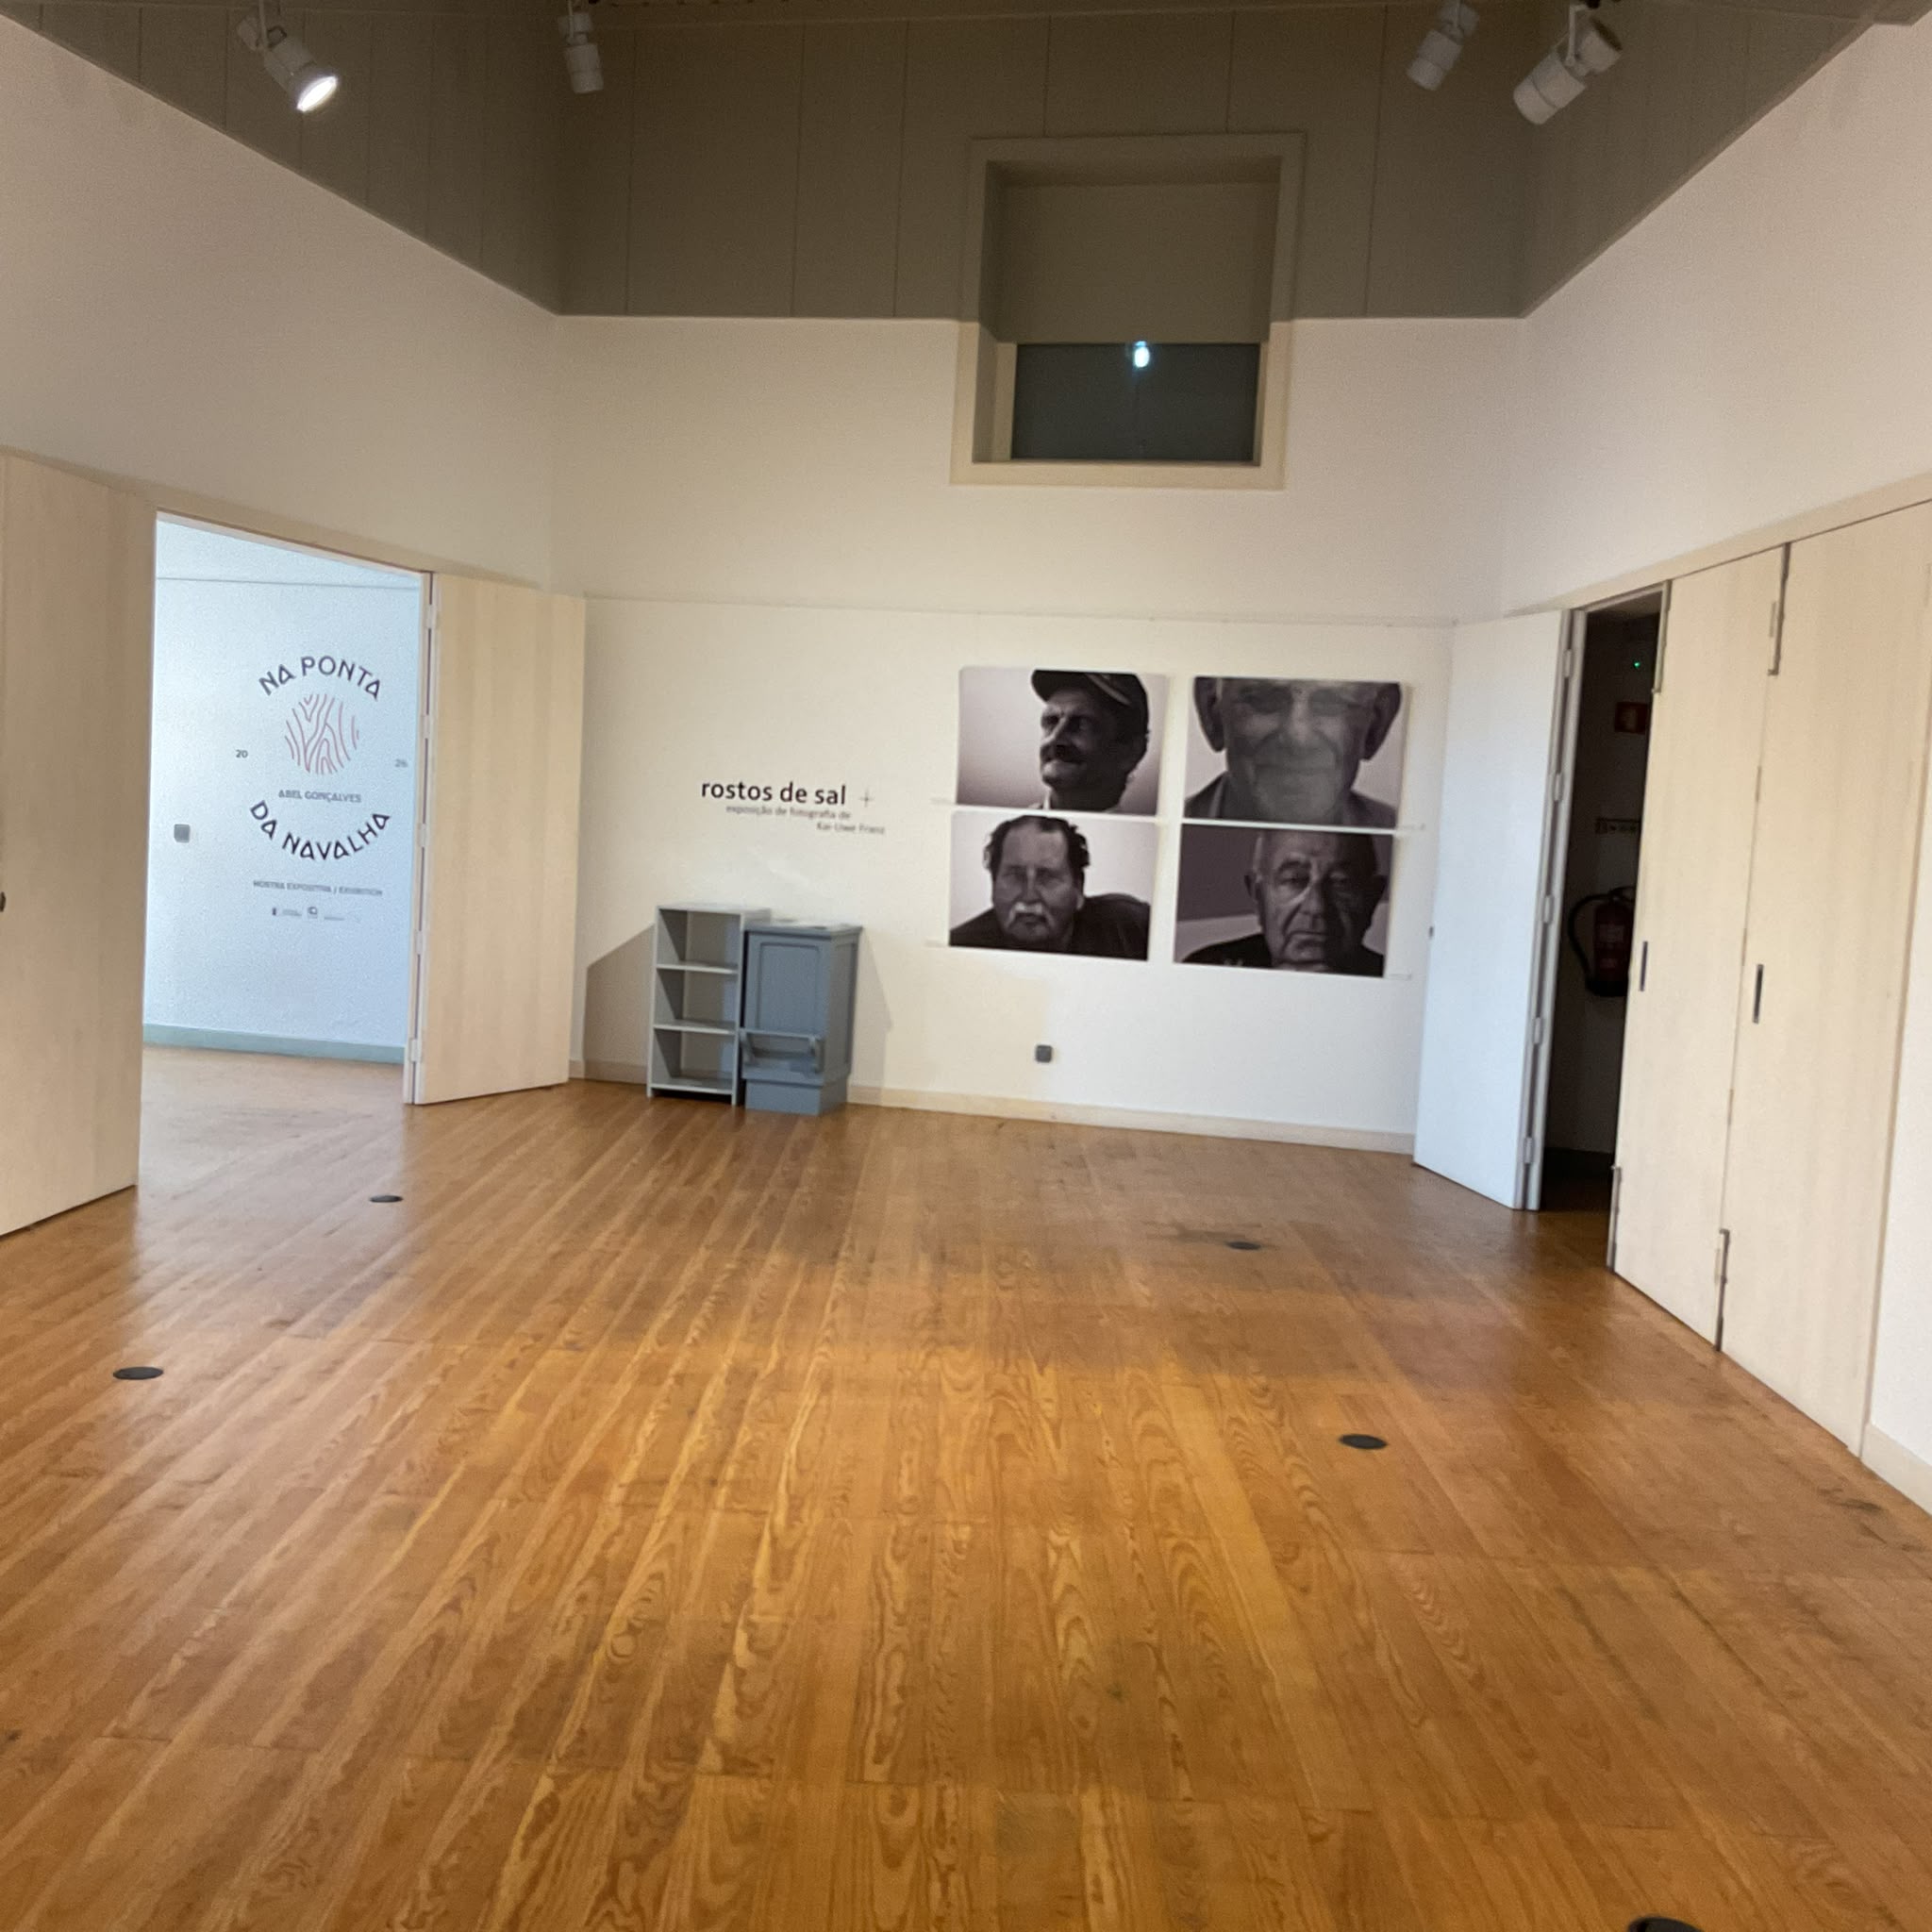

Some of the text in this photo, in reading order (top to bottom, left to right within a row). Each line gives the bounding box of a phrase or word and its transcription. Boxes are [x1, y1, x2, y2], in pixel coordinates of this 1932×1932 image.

[258, 656, 381, 701] NA PONTA
[236, 750, 248, 758] 20
[278, 790, 361, 803] ABEL GONÇALVES
[701, 781, 846, 805] rostos de sal
[250, 800, 391, 860] DA NAVALHA
